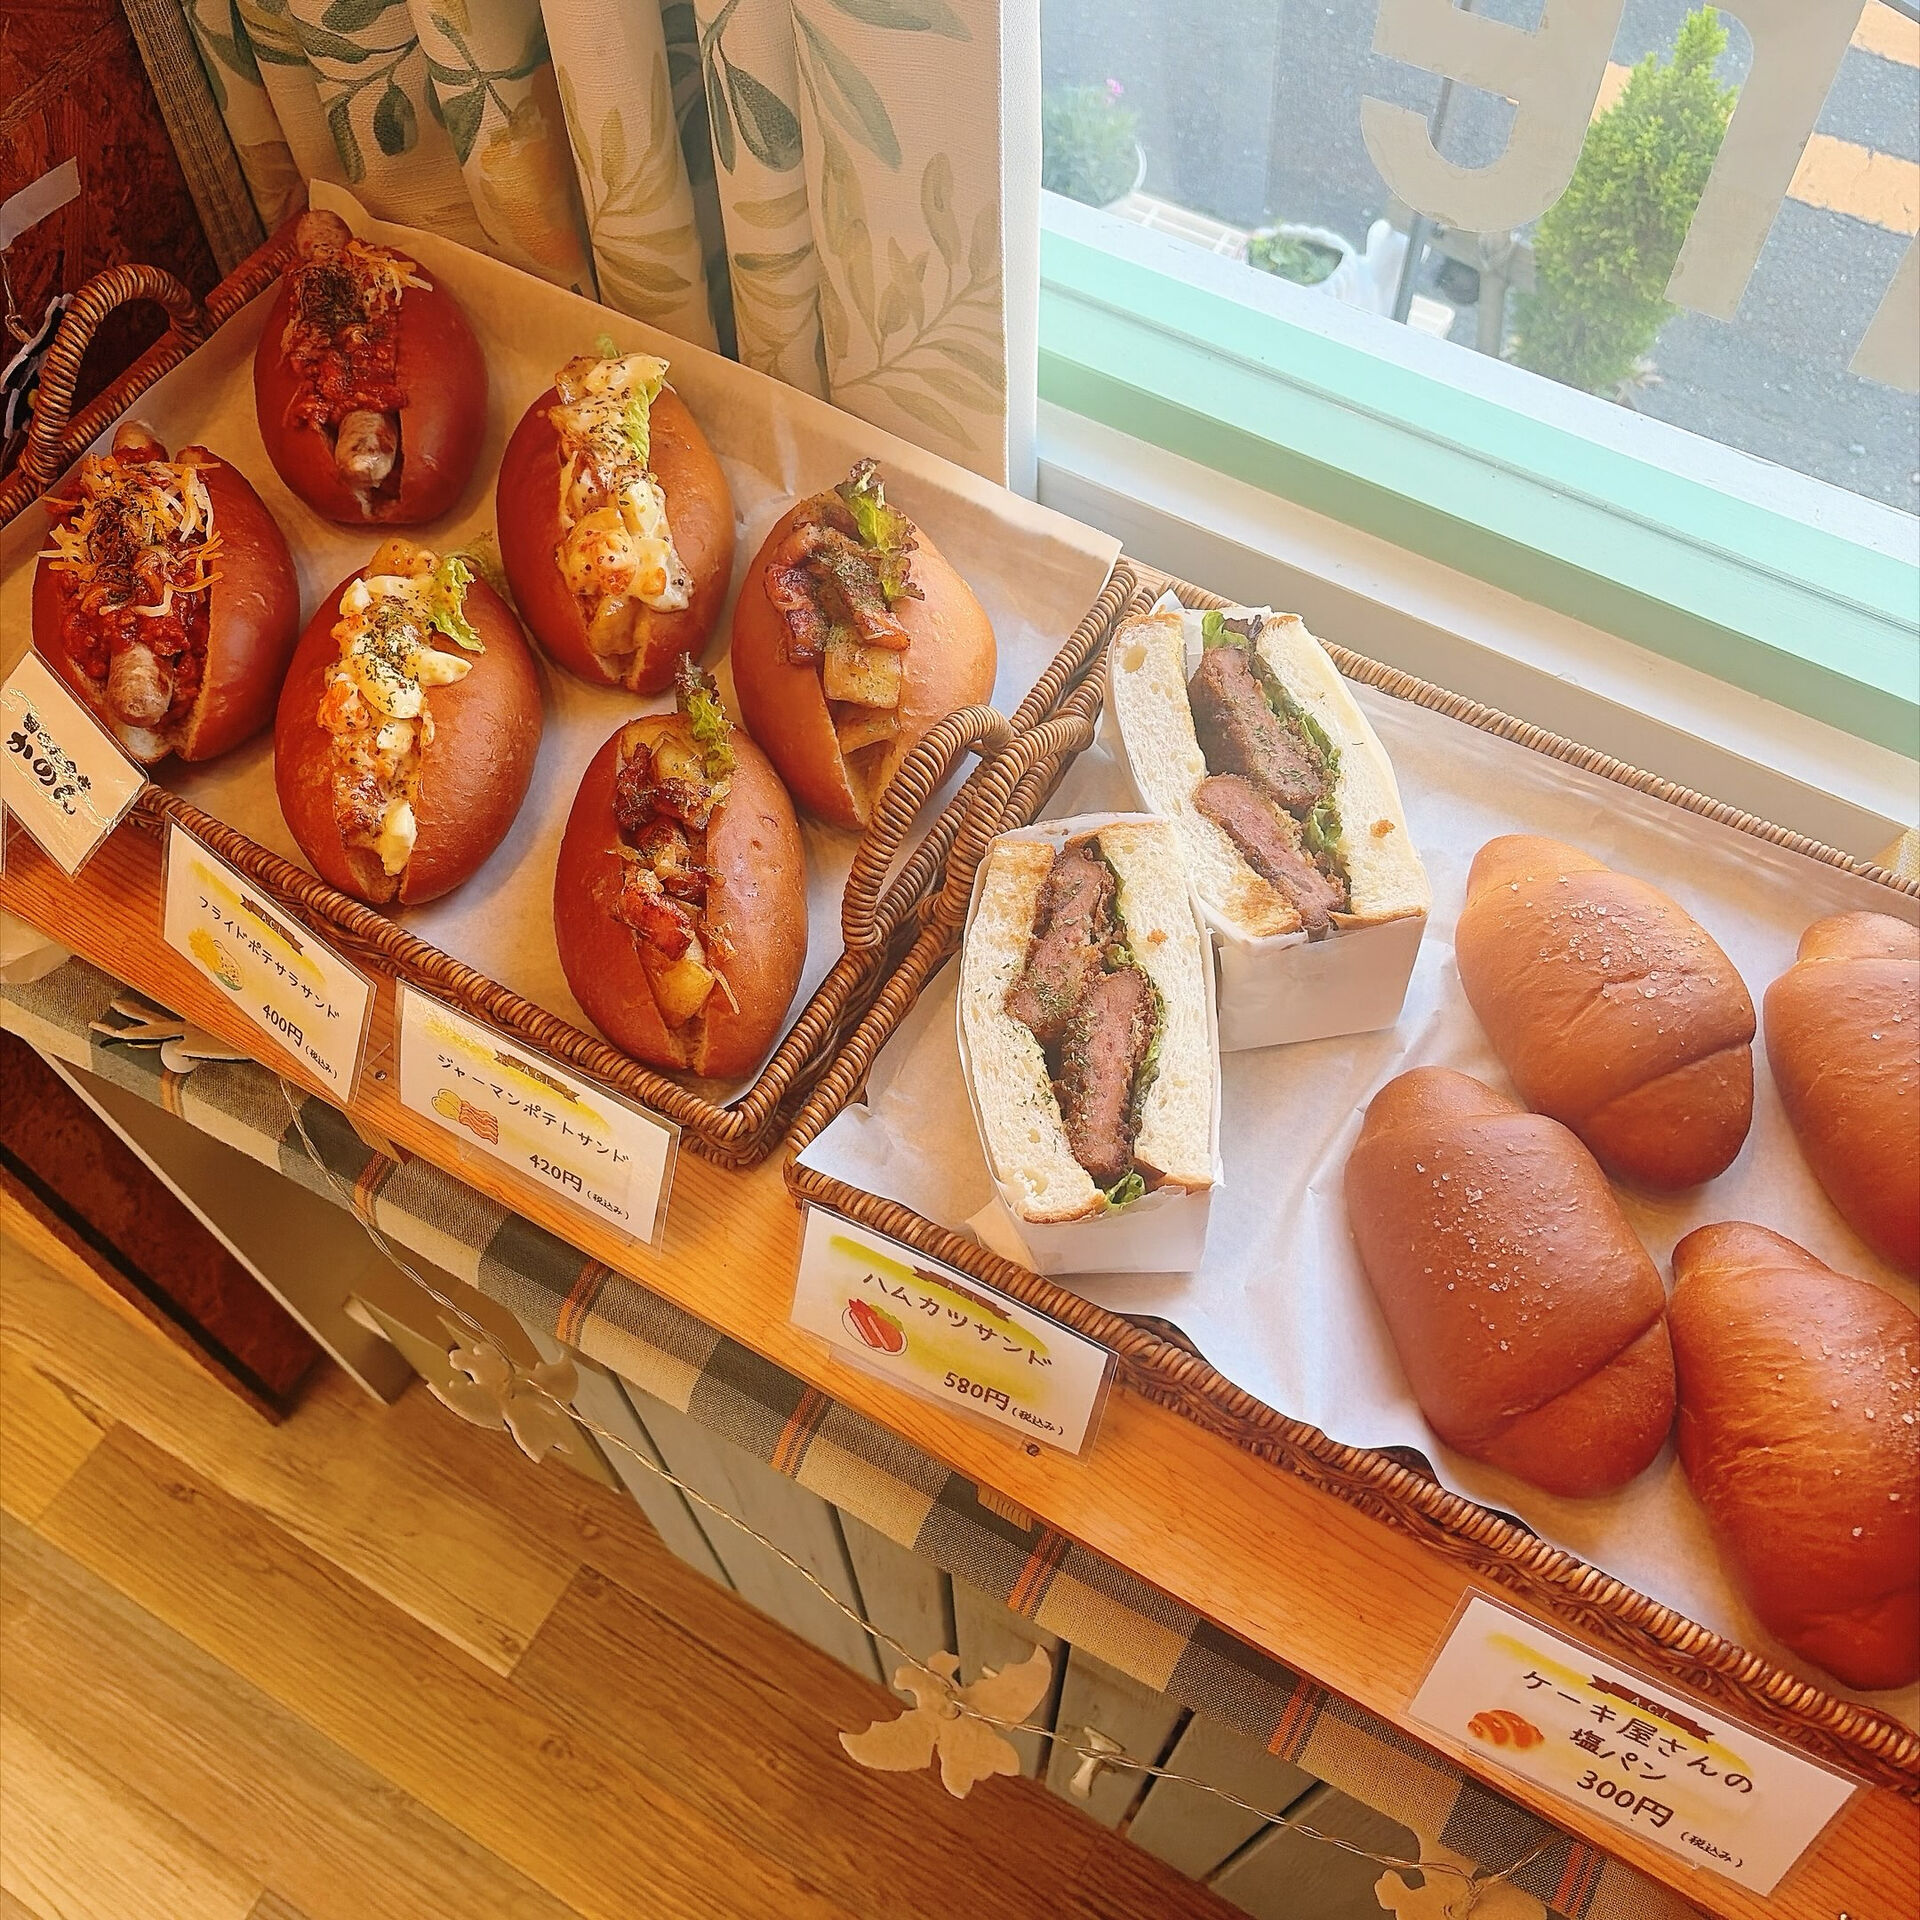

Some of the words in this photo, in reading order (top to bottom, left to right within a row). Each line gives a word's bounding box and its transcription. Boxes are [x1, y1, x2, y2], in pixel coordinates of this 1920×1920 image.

[199, 895, 340, 1019] フライドポテサラサンド
[262, 1003, 304, 1048] 400円
[437, 1054, 630, 1164] ジャーマンポテトサンド
[529, 1154, 583, 1193] 420円
[863, 1273, 1053, 1367] ハムカツサンド
[943, 1371, 1011, 1411] 580円
[1522, 1670, 1754, 1794] ケーキ屋さんの
[1569, 1728, 1667, 1780] 塩パン
[1576, 1769, 1675, 1828] 300円
